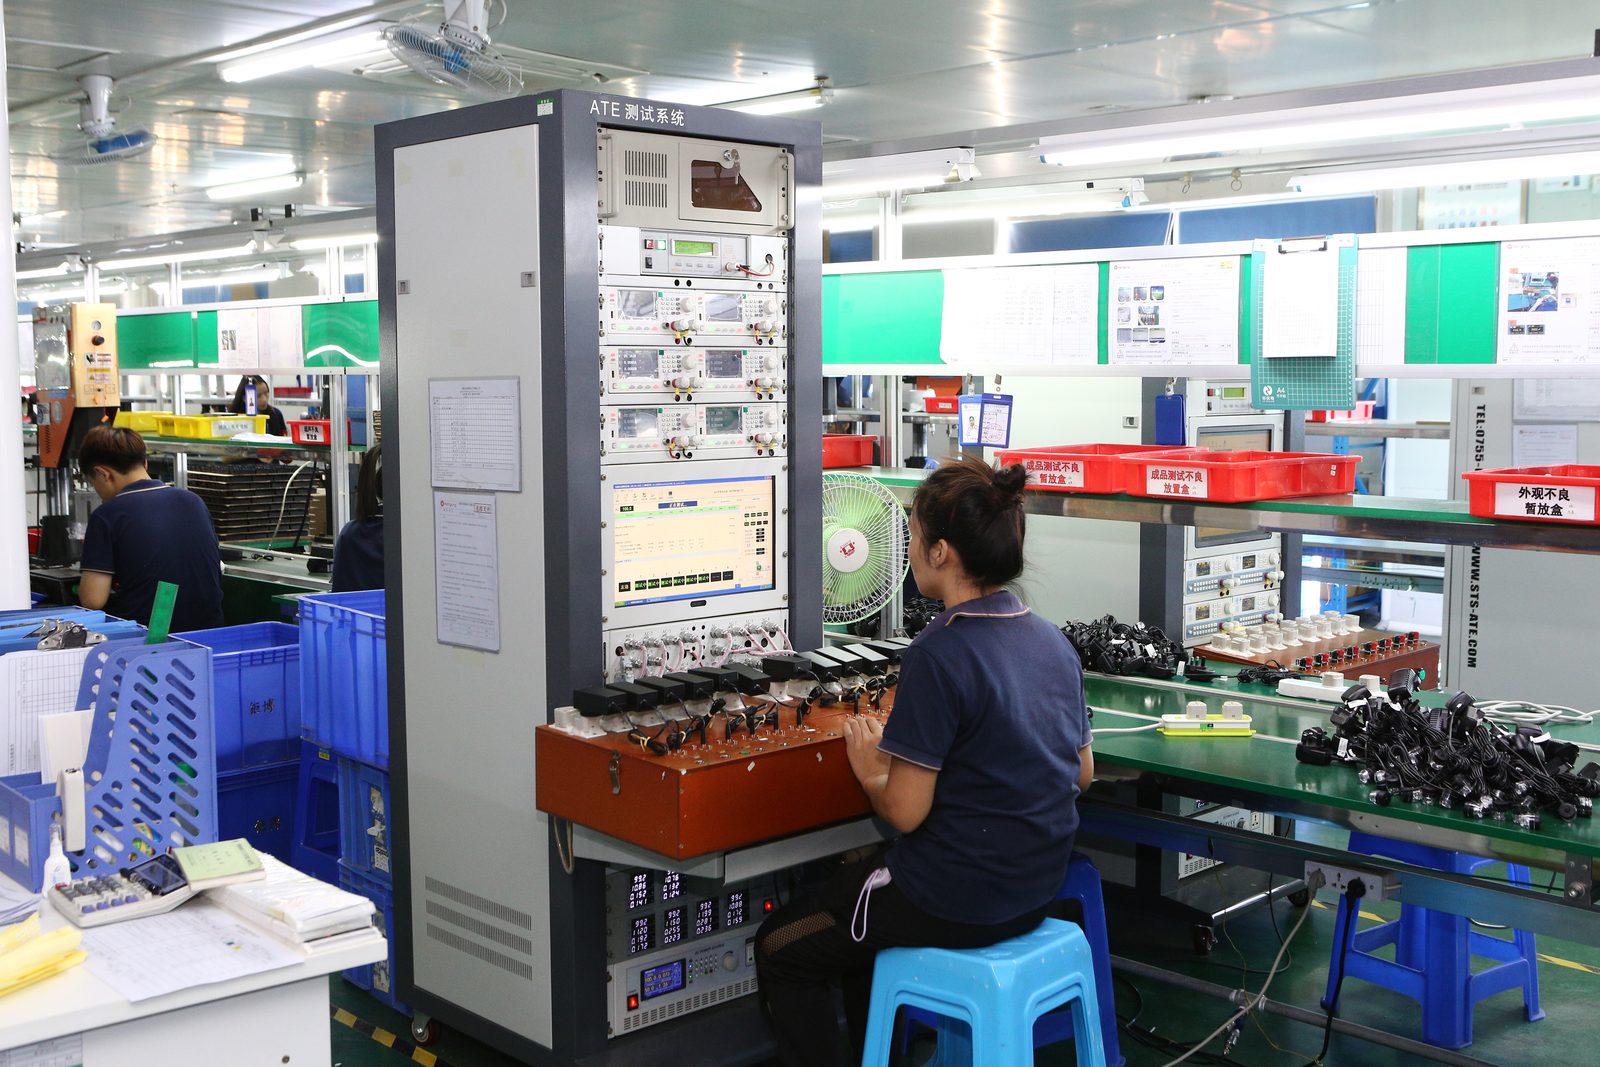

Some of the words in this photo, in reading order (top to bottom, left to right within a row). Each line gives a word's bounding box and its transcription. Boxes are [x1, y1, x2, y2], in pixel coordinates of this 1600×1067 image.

[590, 99, 620, 117] ATE
[625, 103, 685, 127] 测试系统
[1474, 404, 1486, 471] TEL:0755-
[1026, 460, 1080, 473] 成品测试不良
[1040, 473, 1066, 485] 暂放盒
[1151, 469, 1203, 483] 成品测试不良
[1163, 482, 1190, 495] 放置盒
[1518, 486, 1570, 501] 外观不良
[1525, 502, 1563, 517] 暂放盒
